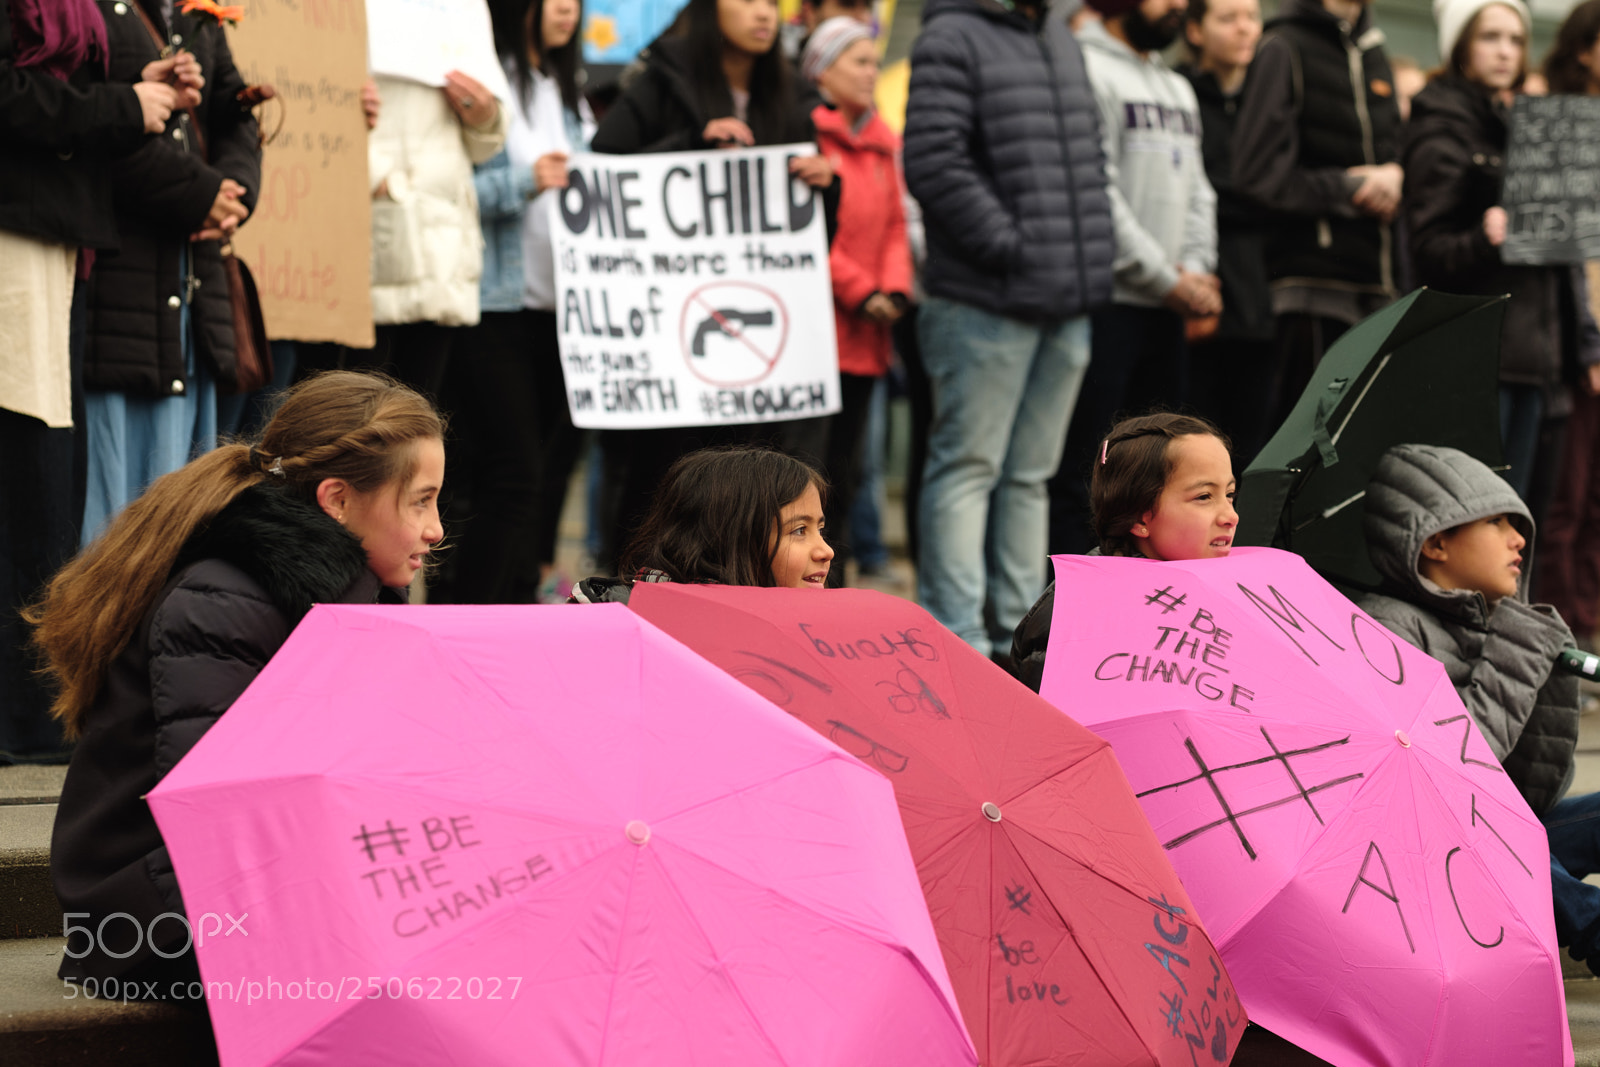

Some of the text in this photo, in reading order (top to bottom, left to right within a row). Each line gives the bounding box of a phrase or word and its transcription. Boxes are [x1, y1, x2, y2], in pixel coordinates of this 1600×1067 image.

[560, 154, 815, 239] ONE CHILD
[588, 249, 644, 275] worth
[653, 251, 728, 275] more
[742, 243, 816, 274] than
[564, 288, 624, 338] ALL
[568, 344, 594, 374] the
[600, 378, 678, 411] EARTH
[1153, 625, 1230, 674] THE
[1094, 652, 1255, 714] CHANGE
[361, 856, 453, 899] THE
[1005, 975, 1071, 1006] love
